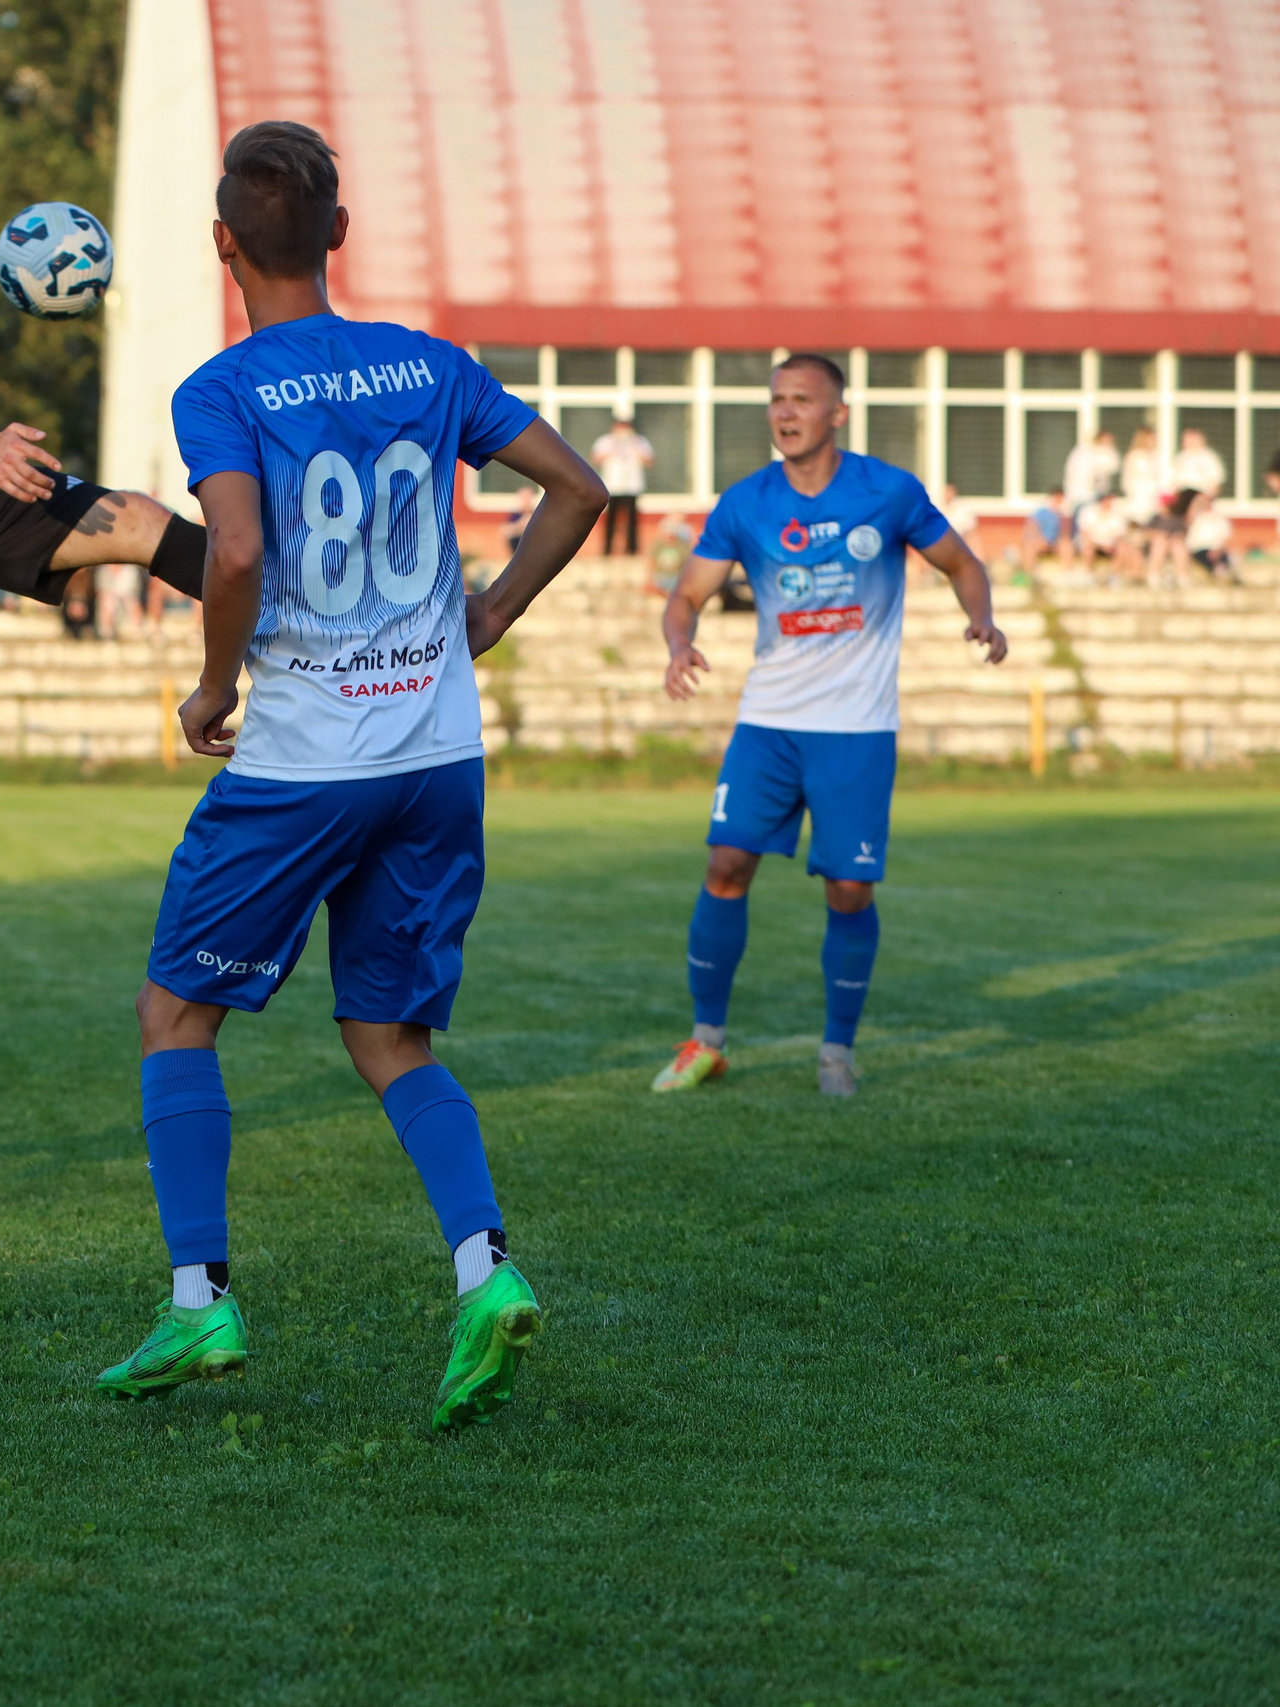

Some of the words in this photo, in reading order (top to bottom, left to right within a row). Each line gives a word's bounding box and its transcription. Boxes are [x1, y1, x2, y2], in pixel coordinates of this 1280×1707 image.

[255, 358, 435, 411] ВОЛЖАНИН
[302, 440, 440, 617] 80
[288, 658, 326, 672] No
[340, 675, 434, 697] SAMARA
[196, 950, 280, 979] ФУДЖИ
